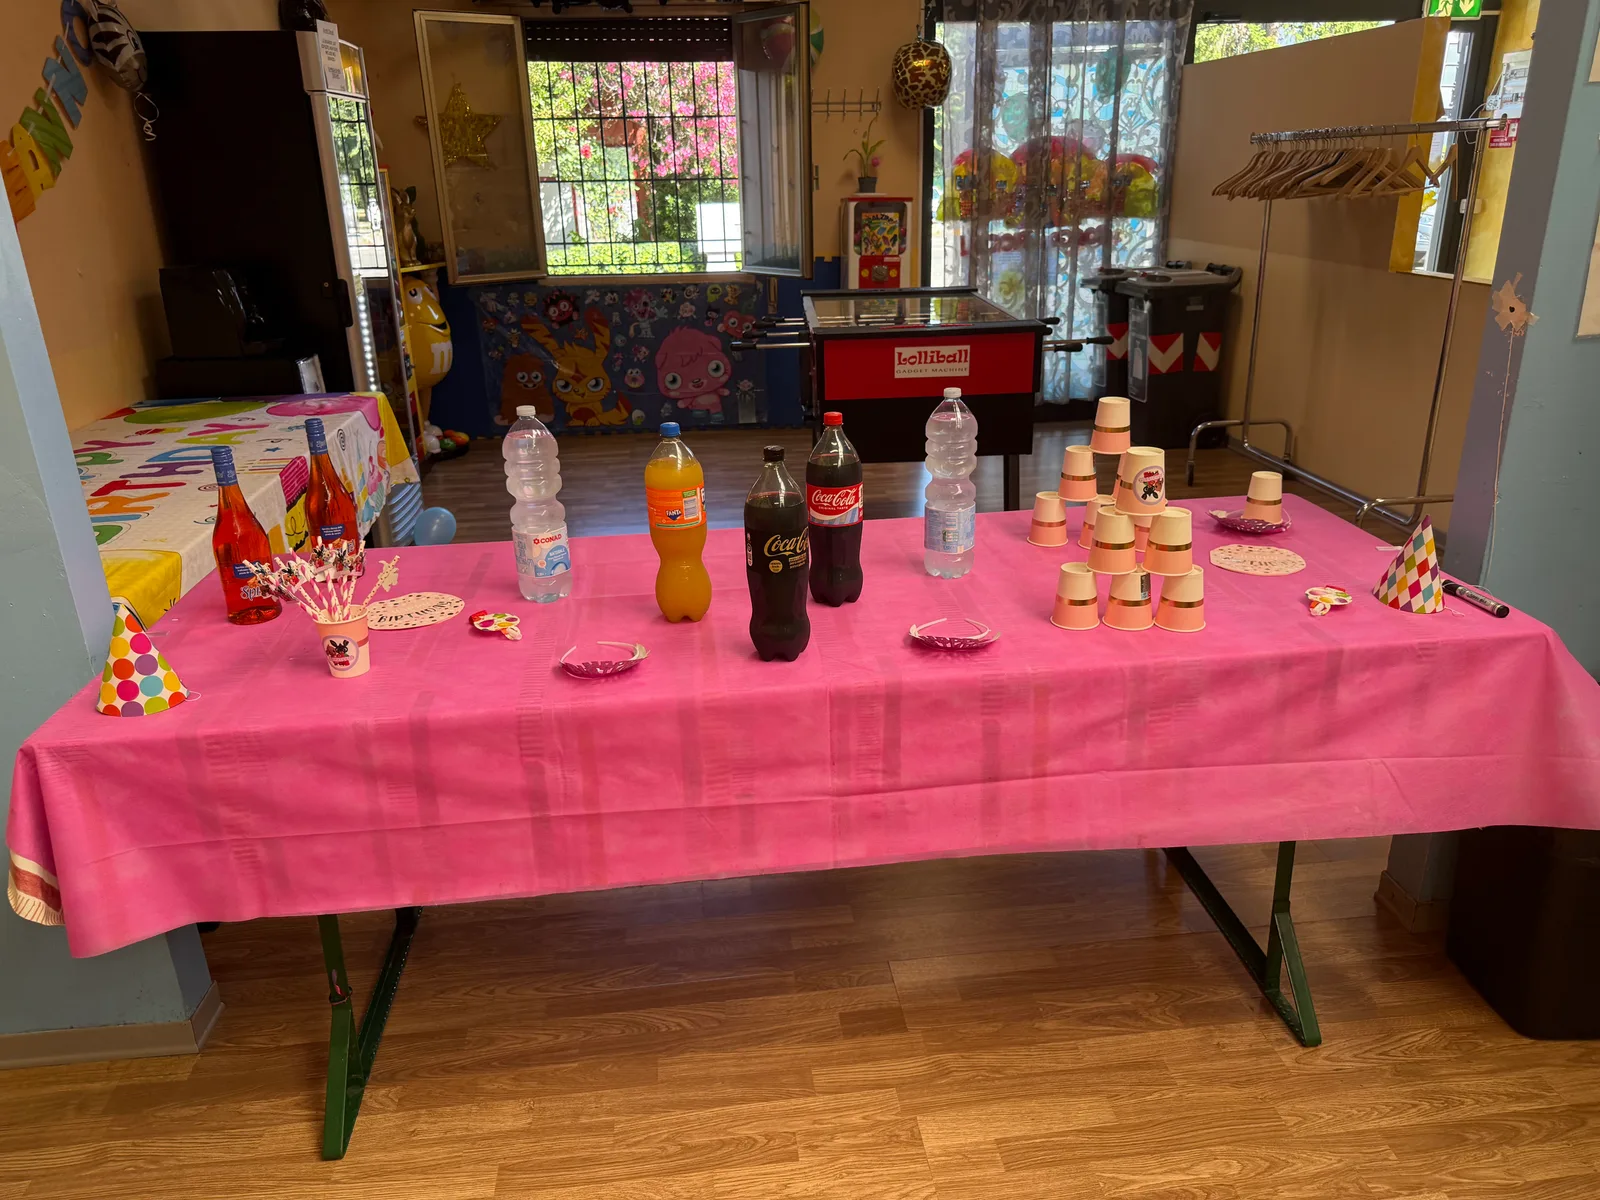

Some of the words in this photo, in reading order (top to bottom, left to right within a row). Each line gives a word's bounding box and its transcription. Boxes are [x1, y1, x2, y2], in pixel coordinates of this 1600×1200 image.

[896, 349, 969, 366] Lolliball
[812, 488, 857, 506] Coca-Cola
[540, 533, 562, 544] CONAD
